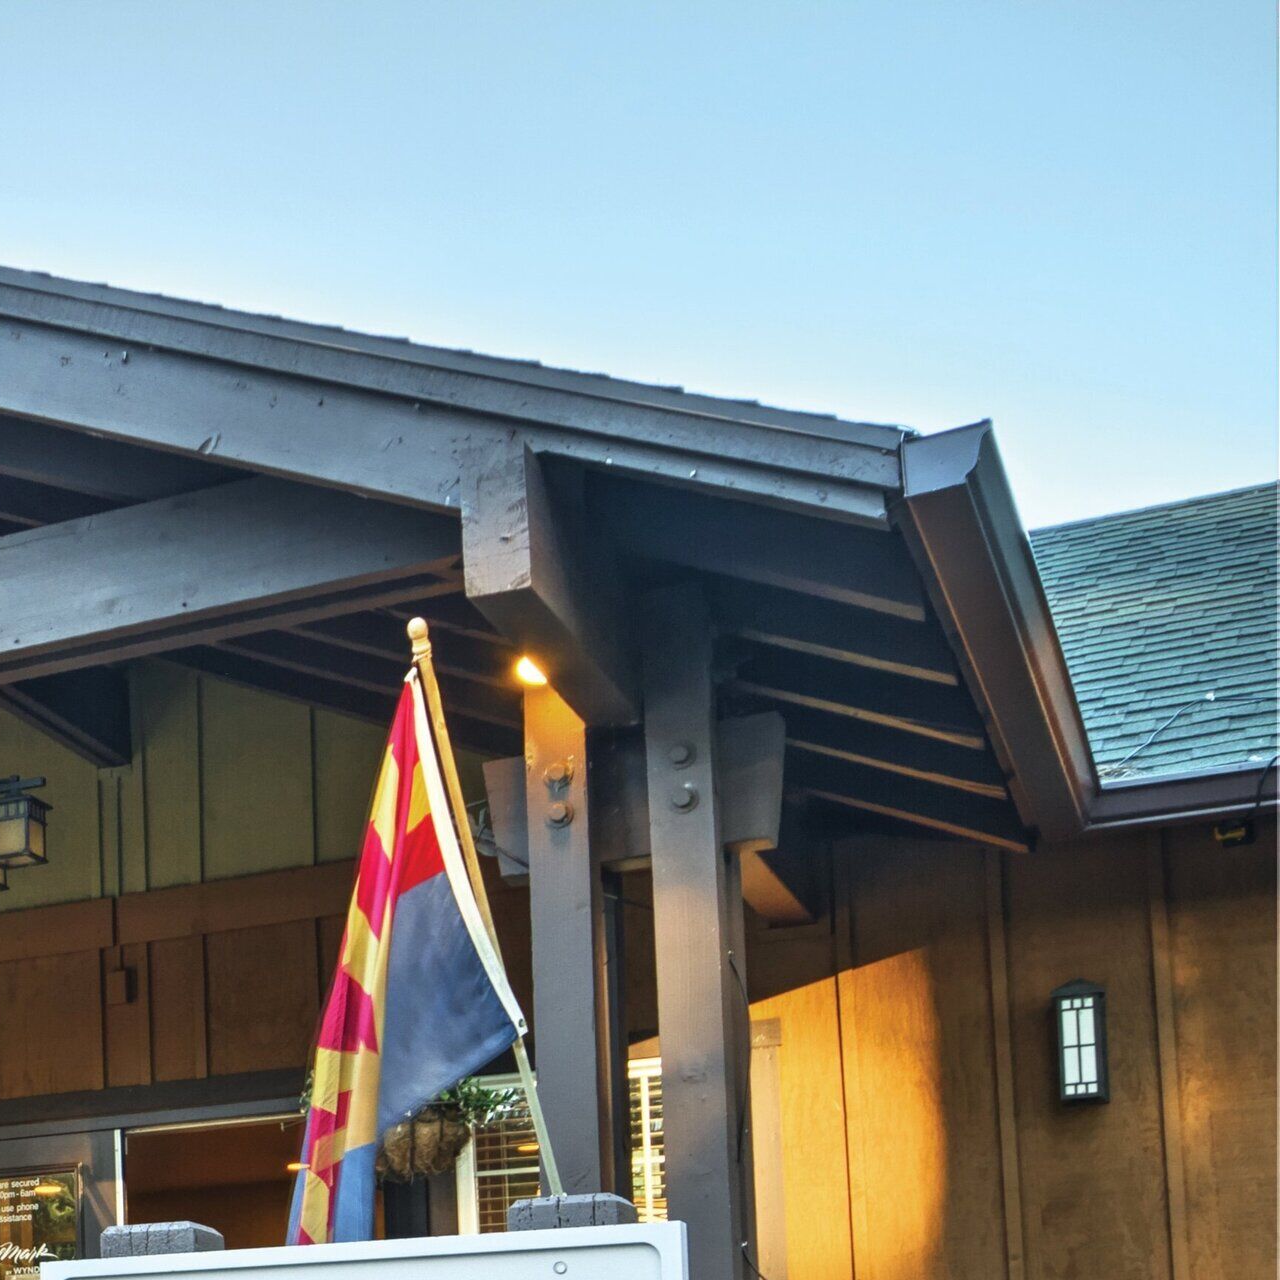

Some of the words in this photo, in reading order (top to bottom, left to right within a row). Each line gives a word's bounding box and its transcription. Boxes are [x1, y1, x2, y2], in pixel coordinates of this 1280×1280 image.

[11, 1178, 40, 1188] secured
[16, 1203, 39, 1213] phone
[13, 1266, 40, 1275] WYND
